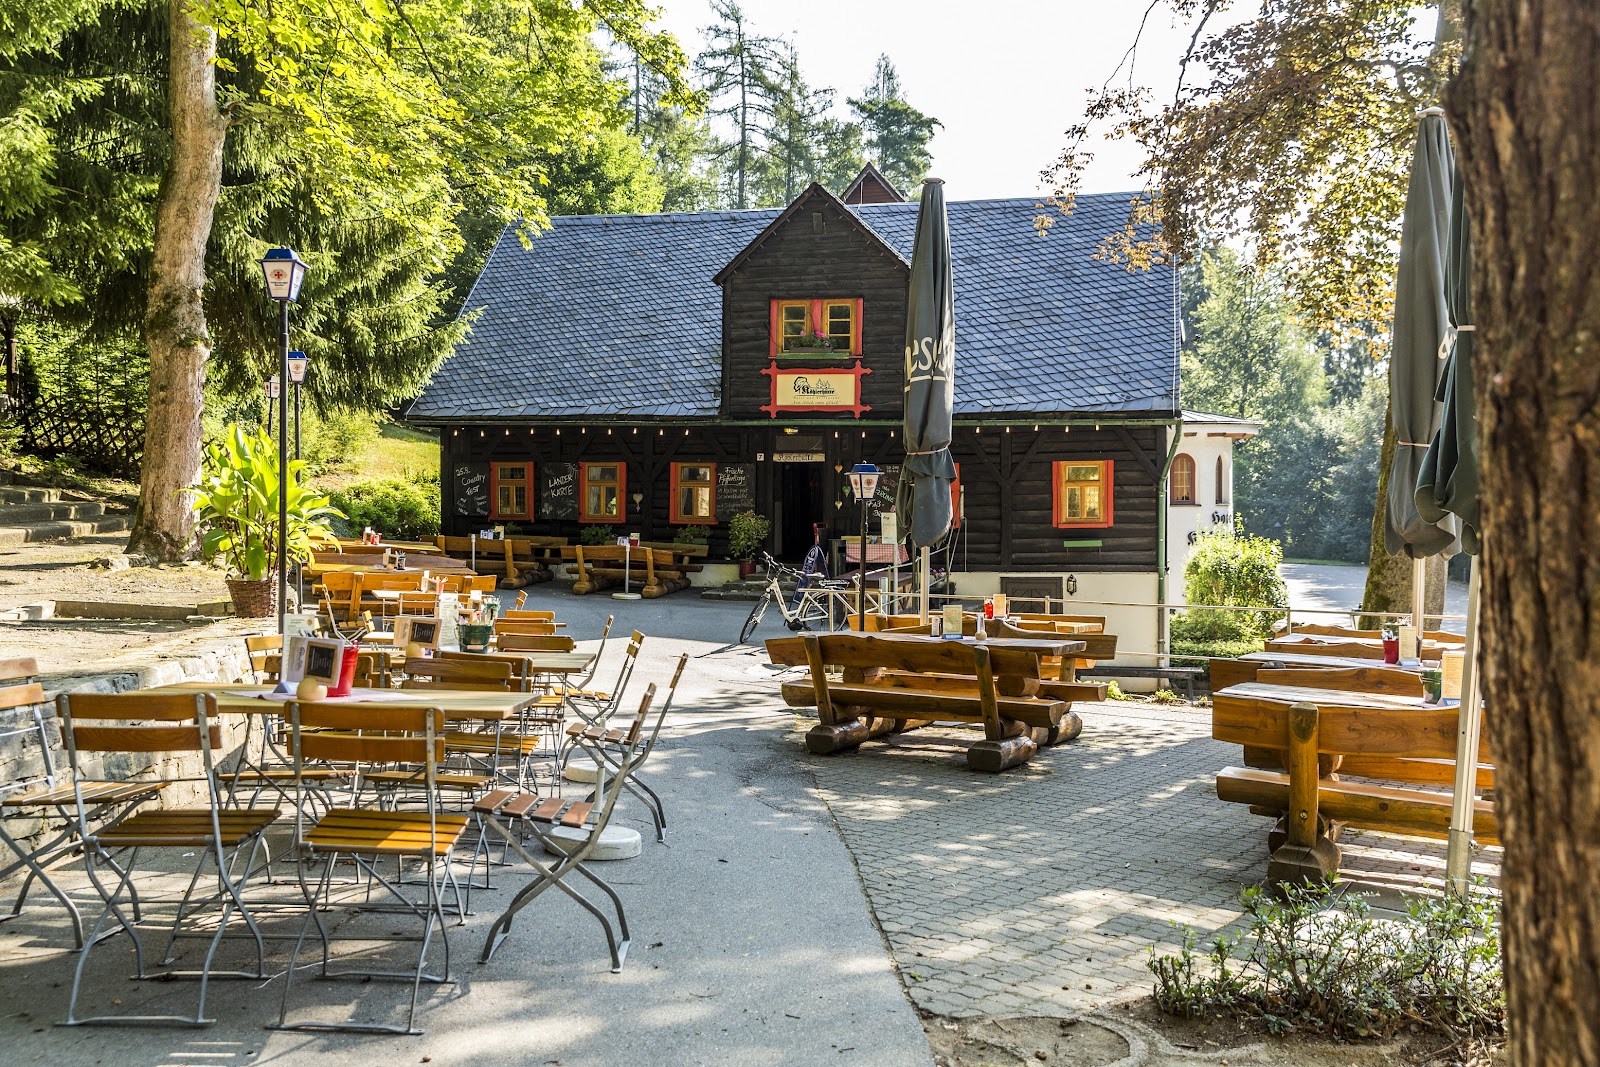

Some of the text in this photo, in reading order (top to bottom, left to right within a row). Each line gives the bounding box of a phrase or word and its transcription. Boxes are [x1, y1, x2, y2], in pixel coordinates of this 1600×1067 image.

[724, 466, 745, 475] Frische
[461, 472, 486, 486] Country
[550, 484, 573, 498] KARTE
